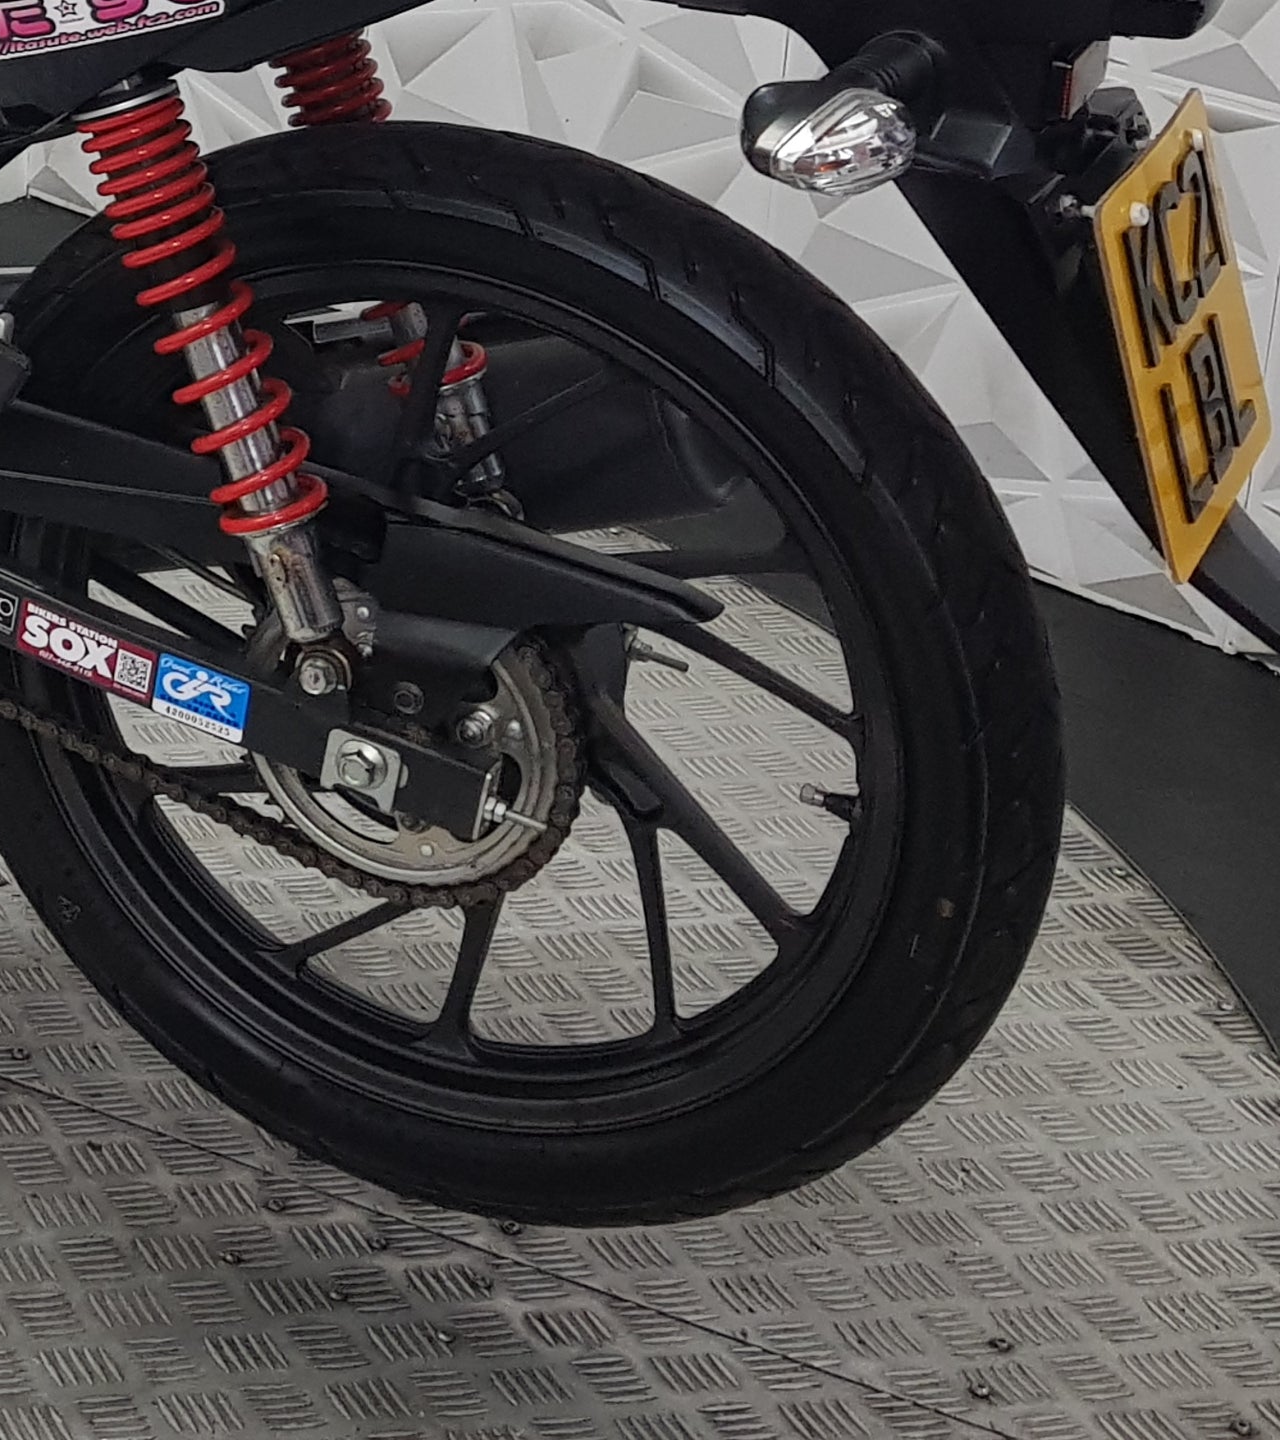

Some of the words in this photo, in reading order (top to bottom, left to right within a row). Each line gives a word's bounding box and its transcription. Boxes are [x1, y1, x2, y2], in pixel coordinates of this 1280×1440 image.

[1123, 146, 1228, 369] KC21
[1160, 313, 1258, 524] LBL
[22, 615, 114, 679] SOX
[27, 603, 68, 627] BIKERS
[69, 620, 118, 649] STATION
